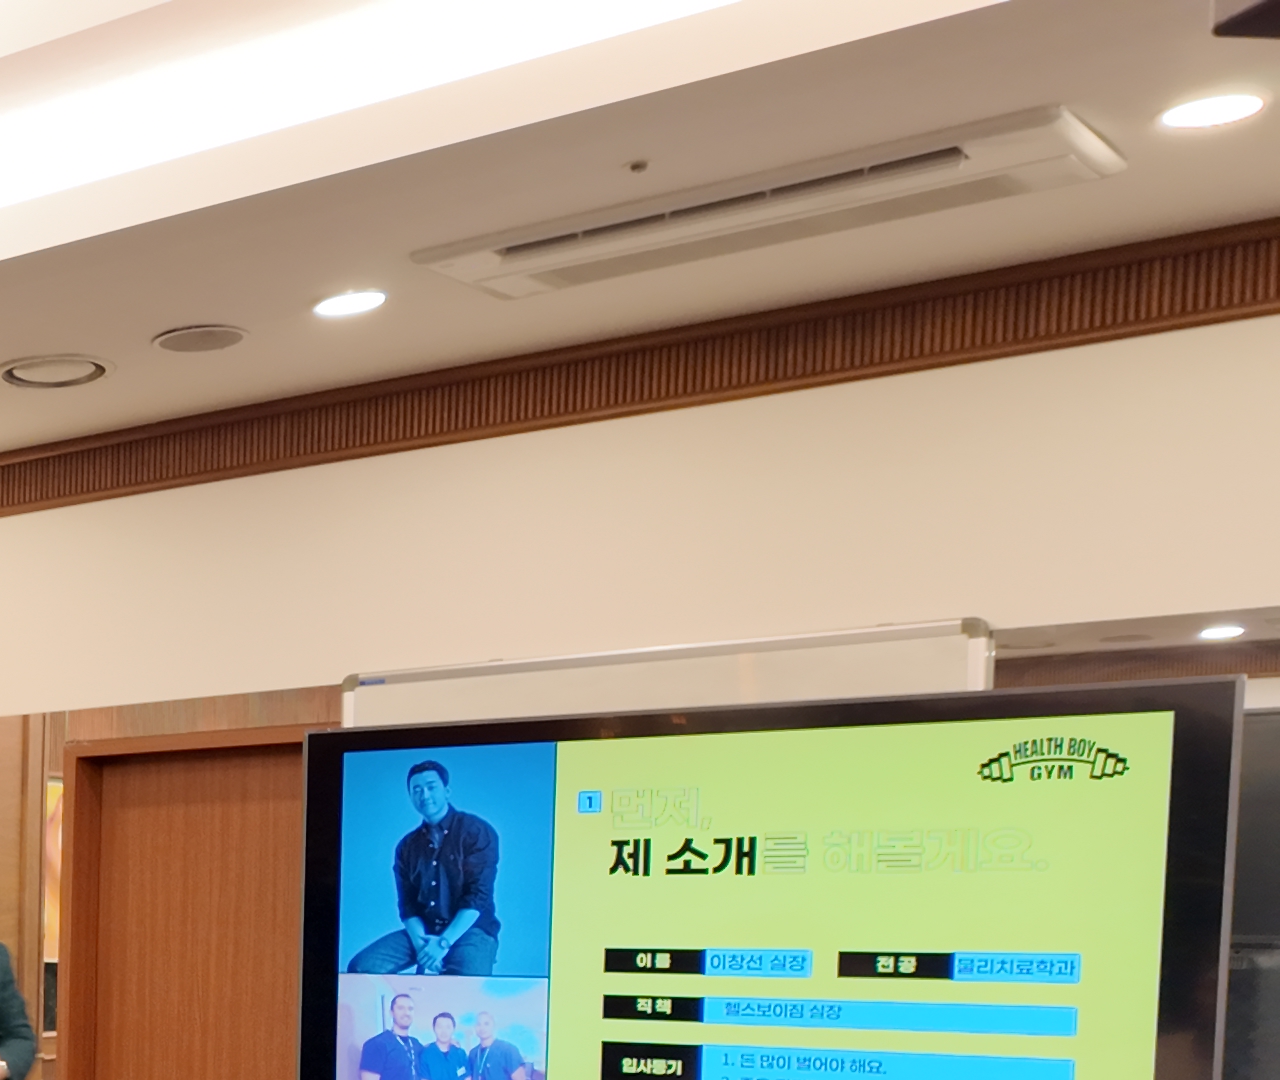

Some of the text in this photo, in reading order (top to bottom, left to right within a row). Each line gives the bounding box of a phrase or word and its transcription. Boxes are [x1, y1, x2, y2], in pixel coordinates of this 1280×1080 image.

[1012, 737, 1096, 760] HEALTH BOY
[1030, 765, 1073, 781] GYM
[609, 838, 652, 876] 제
[710, 955, 807, 972] 이창선 실장
[722, 1053, 735, 1066] 1.
[760, 1055, 791, 1070] 많이
[849, 1058, 887, 1075] 해요.
